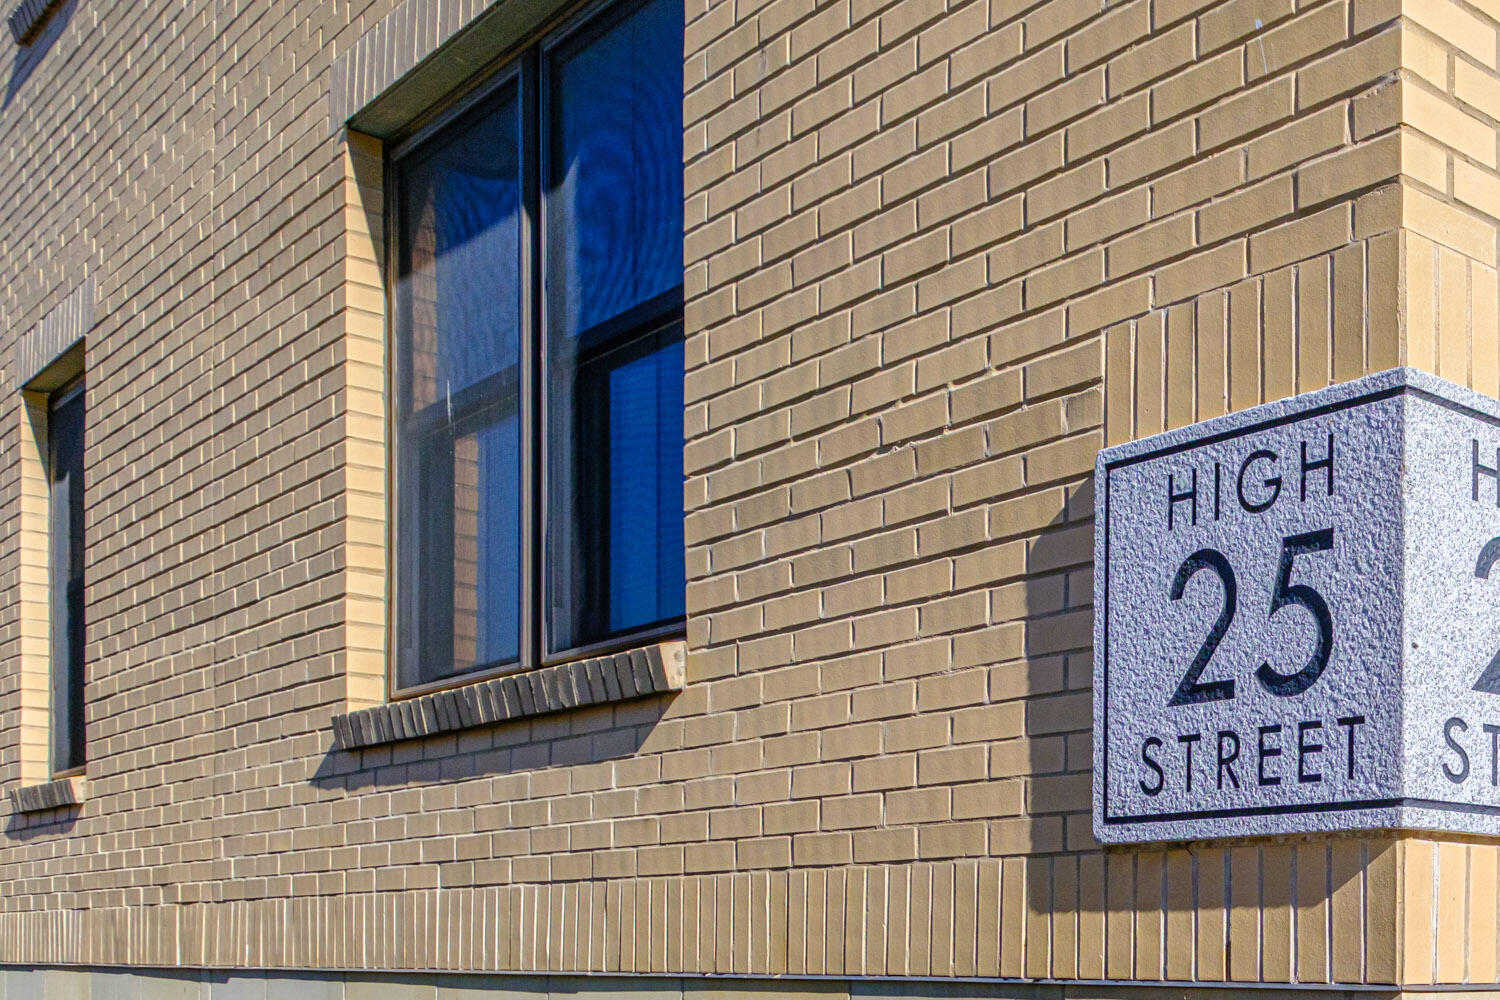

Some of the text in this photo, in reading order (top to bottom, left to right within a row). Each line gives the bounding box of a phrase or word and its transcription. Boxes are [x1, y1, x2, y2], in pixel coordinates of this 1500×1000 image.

[1167, 433, 1335, 531] HIGH
[1167, 527, 1335, 707] 25
[1139, 715, 1366, 797] STREET
